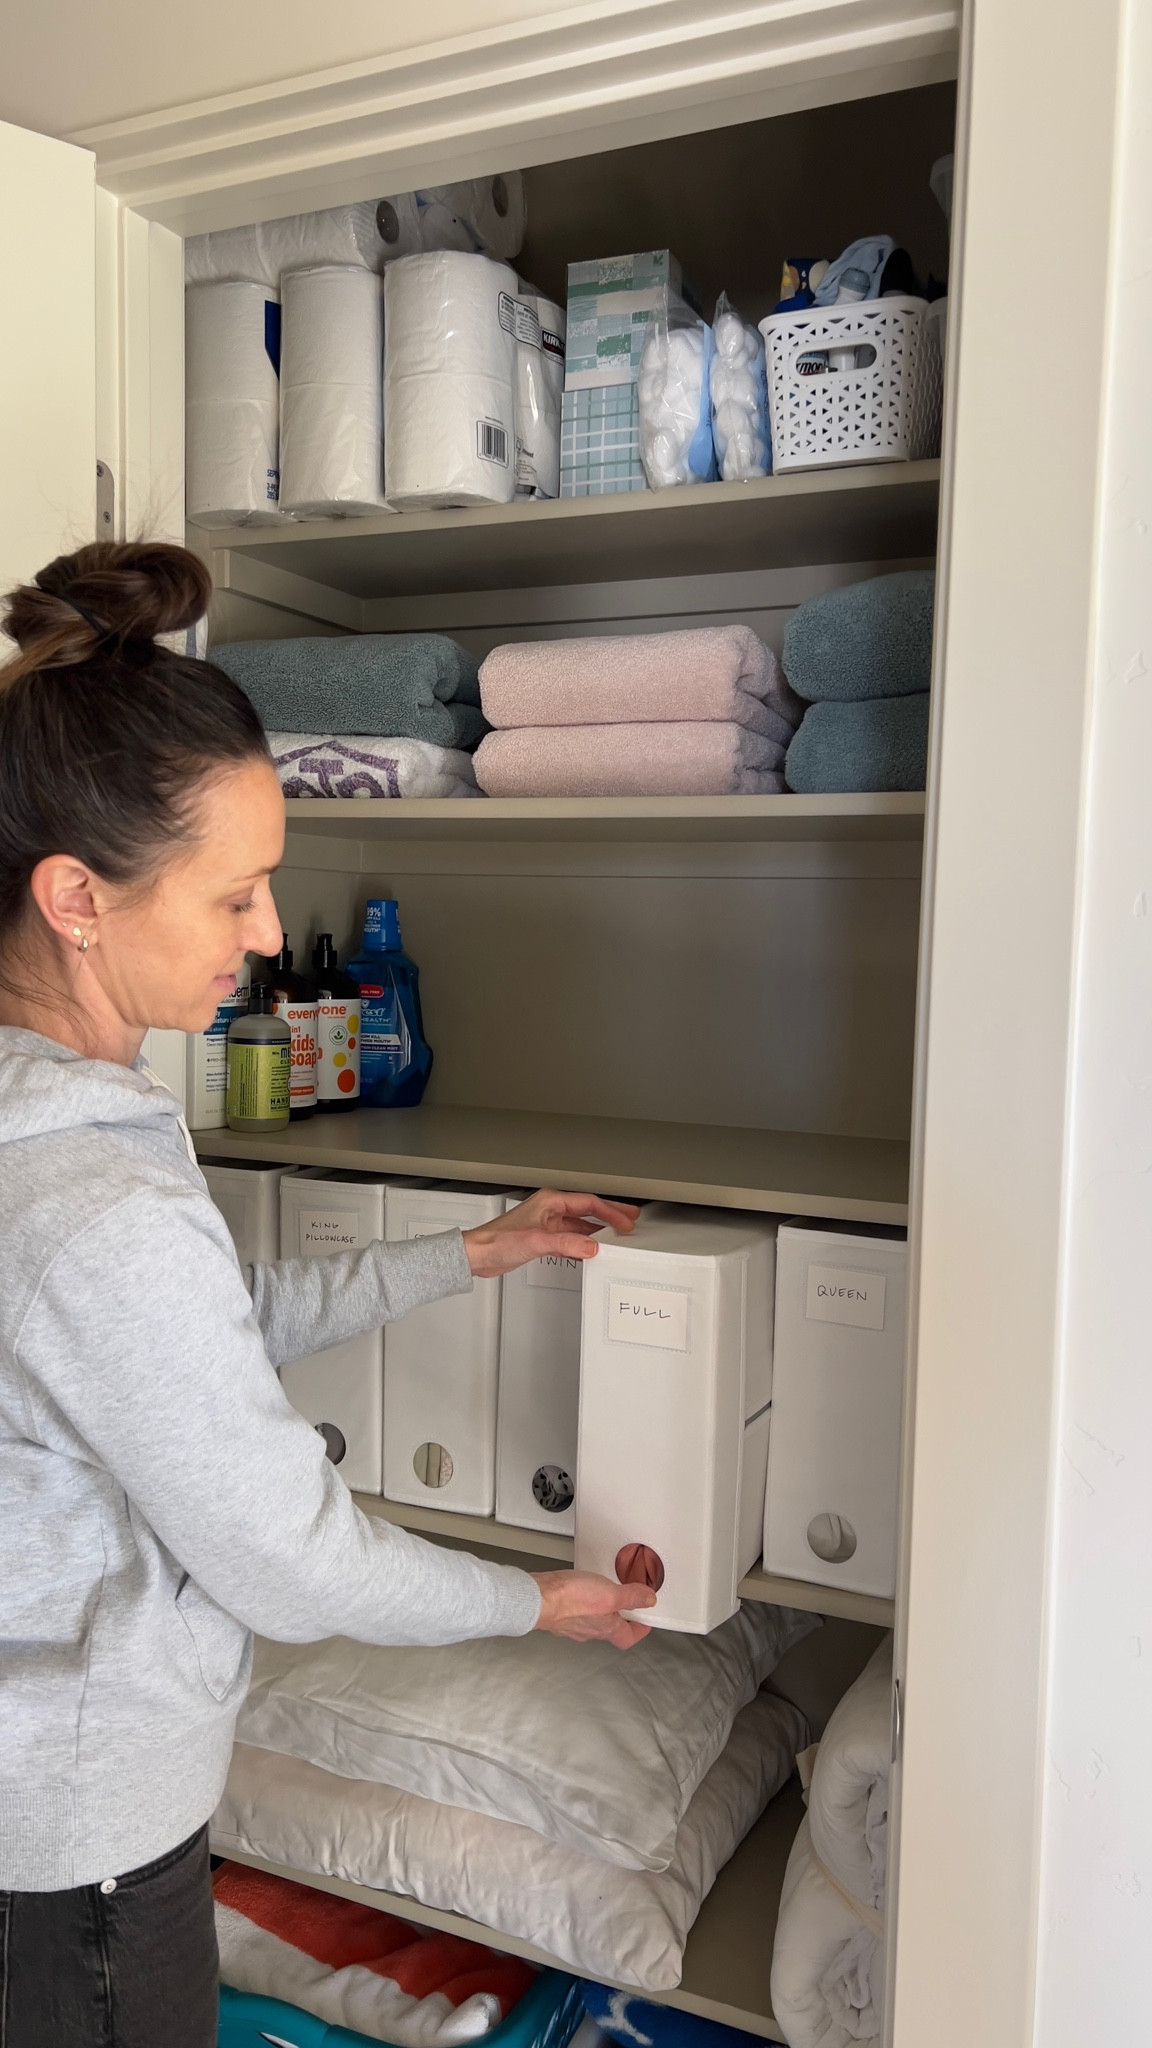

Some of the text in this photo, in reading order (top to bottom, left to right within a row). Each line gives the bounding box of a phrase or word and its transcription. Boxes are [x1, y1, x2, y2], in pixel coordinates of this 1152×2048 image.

[310, 1221, 340, 1229] KING
[305, 1233, 357, 1244] PILLOWCASE
[816, 1284, 868, 1301] QUEEN
[618, 1302, 671, 1319] FULL
